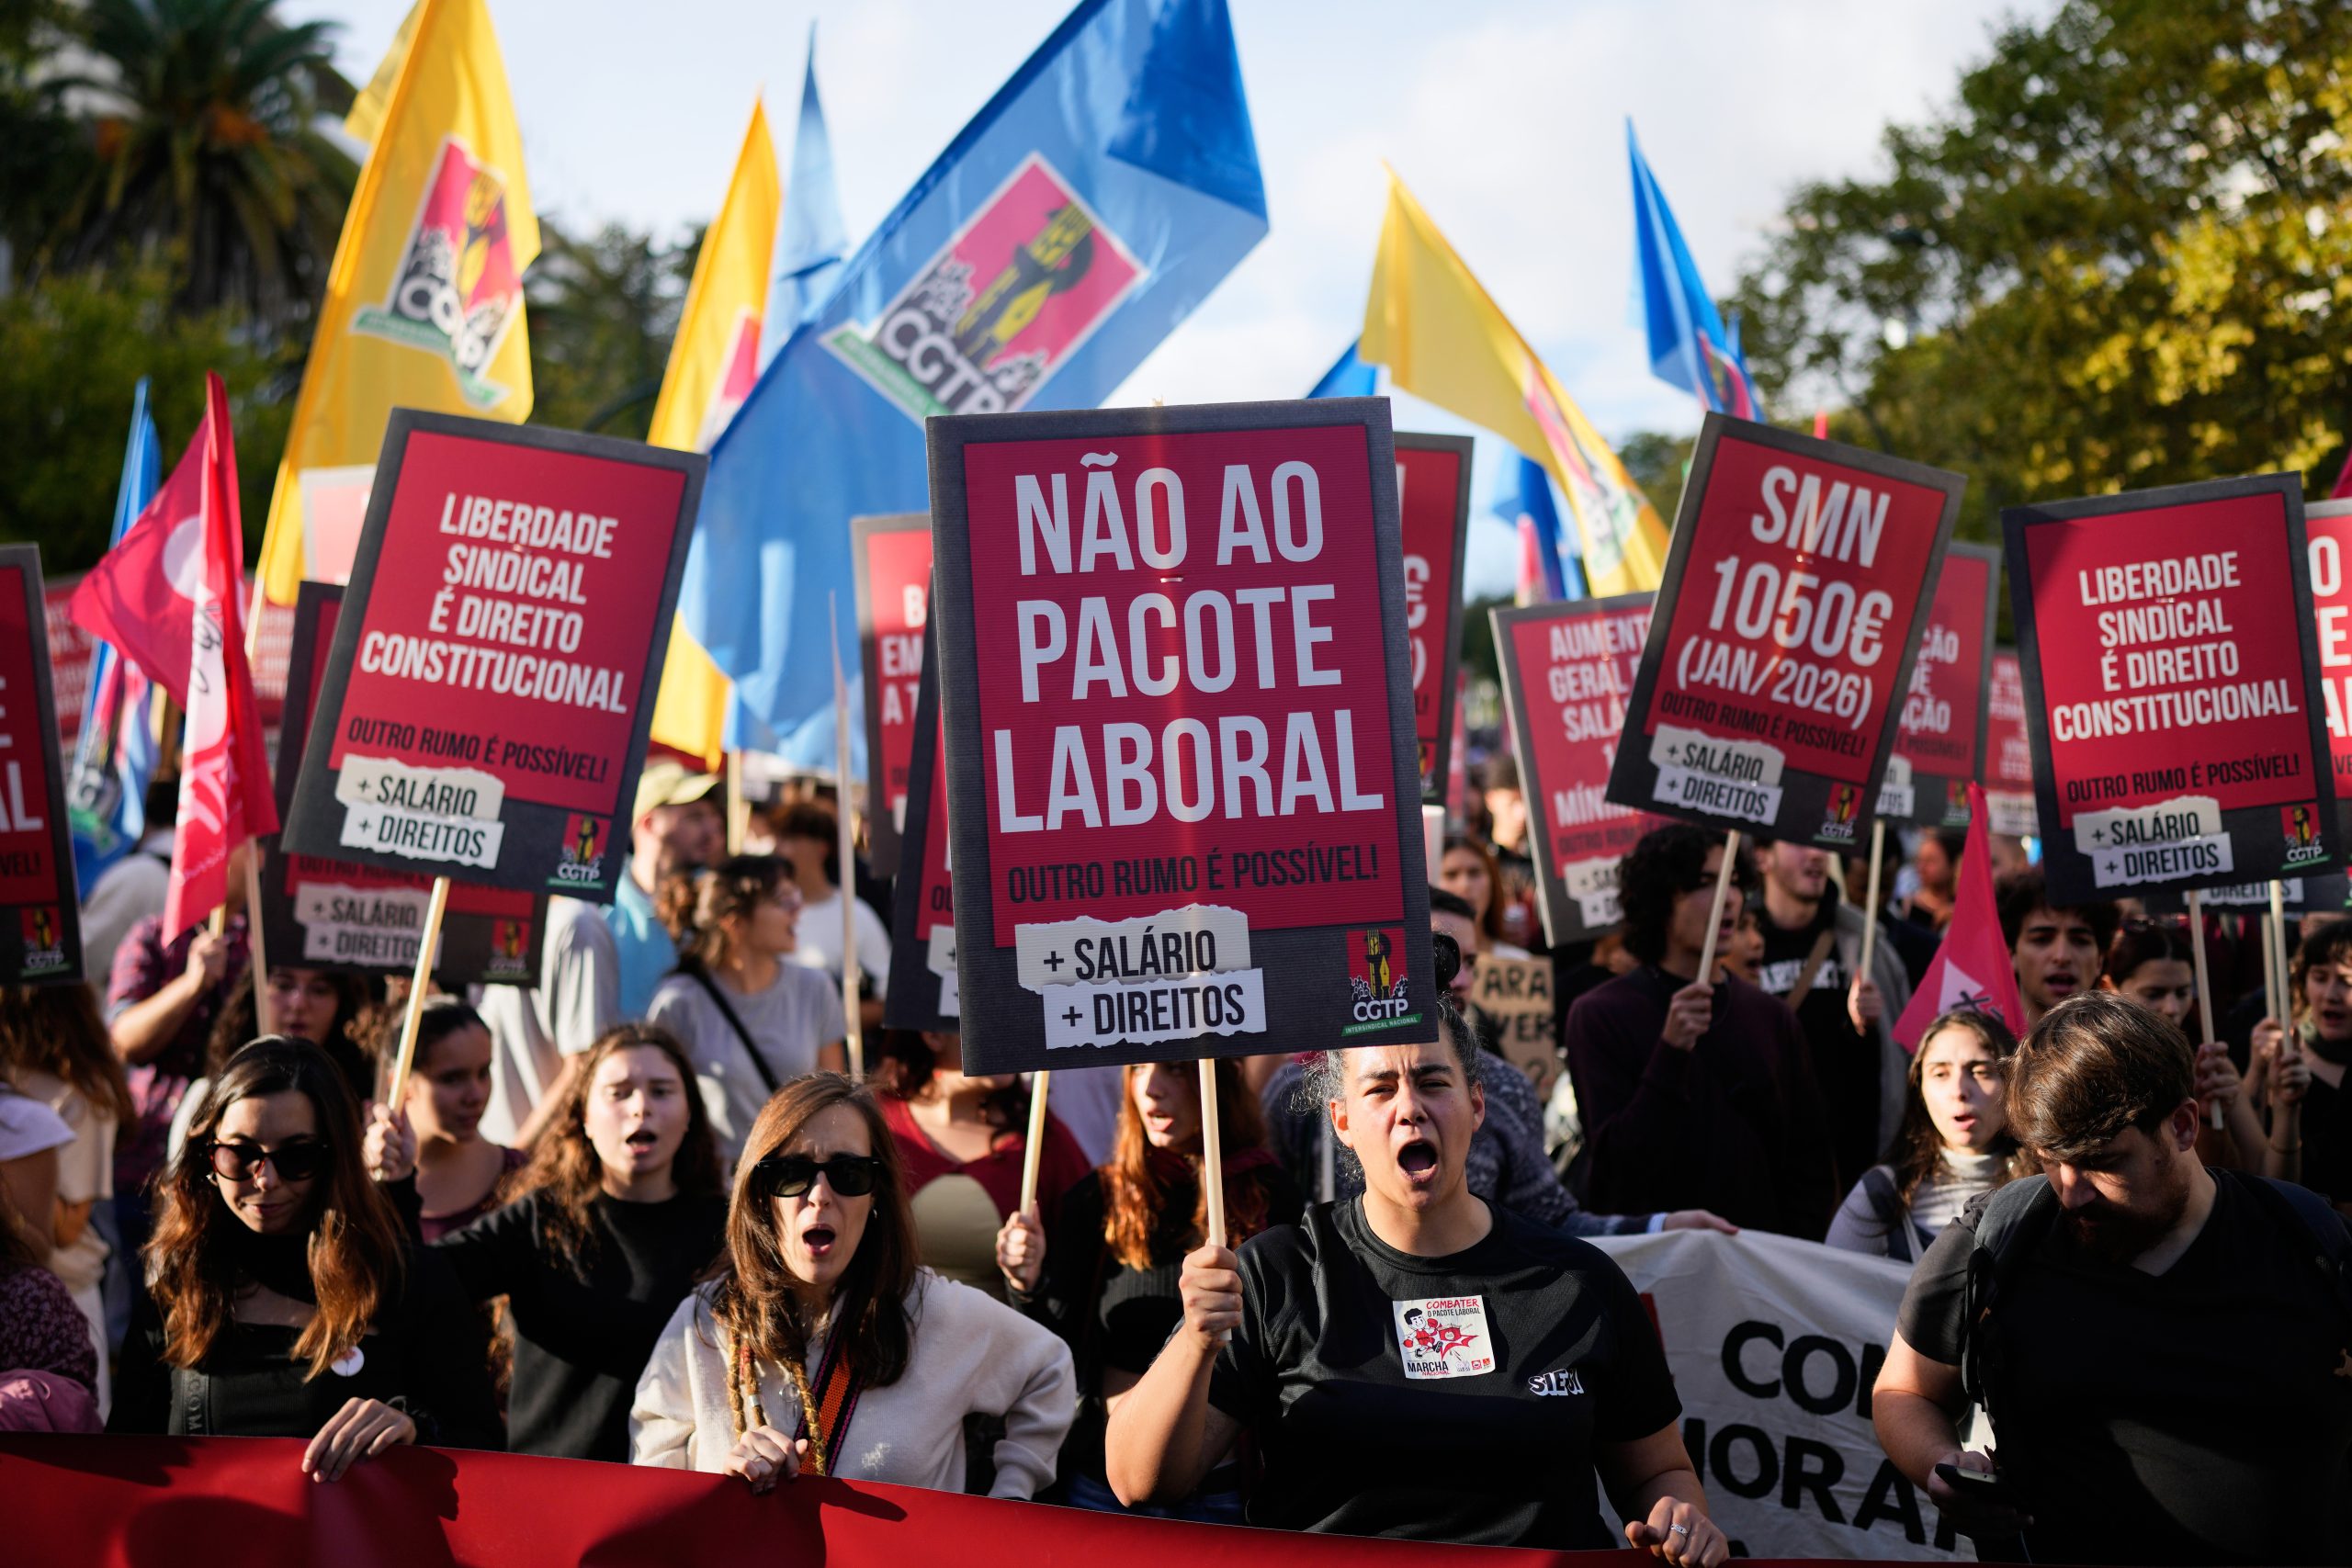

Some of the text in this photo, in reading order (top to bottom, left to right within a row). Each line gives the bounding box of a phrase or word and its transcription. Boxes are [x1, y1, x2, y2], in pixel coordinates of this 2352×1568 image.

[440, 492, 618, 558] LIBERDADE
[1015, 451, 1324, 575] NÃO AO
[1752, 466, 1890, 568] SMN
[444, 544, 587, 604] SINDICAL
[2079, 552, 2240, 606] LIBERDADE
[429, 585, 583, 653] É DIREITO
[1708, 555, 1893, 666] 1050€
[2098, 598, 2232, 648] SINDICAL
[1016, 584, 1342, 703] PACOTE
[1550, 615, 1653, 660] AUMENT
[360, 631, 627, 714] CONSTITUCIONAL
[1549, 659, 1627, 703] GERAL
[1678, 636, 1872, 729] (JAN/2026)
[2101, 641, 2239, 692] É DIREITO
[1661, 691, 1866, 759] OUTRO RUMO É POSSÍVEL!
[2052, 679, 2298, 741] CONSTITUCIONAL
[349, 716, 609, 784] OUTRO RUMO É POSSÍVEL!
[994, 709, 1384, 833] LABORAL
[1682, 742, 1764, 781] SALÁRIO
[377, 775, 477, 817] SALÁRIO
[1682, 777, 1769, 817] DIREITOS
[2067, 753, 2300, 803] OUTRO RUMO É POSSÍVEL!
[379, 815, 485, 859] DIREITOS
[2112, 811, 2199, 846] SALÁRIO
[2287, 845, 2323, 862] CGTP
[558, 863, 600, 882] CGTP
[1010, 840, 1379, 903] OUTRO RUMO É POSSÍVEL!
[2125, 843, 2219, 878] DIREITOS
[2210, 879, 2291, 898] DIREITS
[1075, 926, 1216, 980] SALÁRIO
[1474, 966, 1548, 999] ARA
[1095, 984, 1245, 1036] DIREITOS
[1345, 1016, 1418, 1034] INTERSINDICAL NACIONAL
[1353, 998, 1408, 1021] CGTP
[1426, 1298, 1480, 1310] COMBATER
[1433, 1308, 1454, 1317] PACOTE
[1455, 1307, 1481, 1315] LABORAL
[1408, 1360, 1449, 1372] MARCHA
